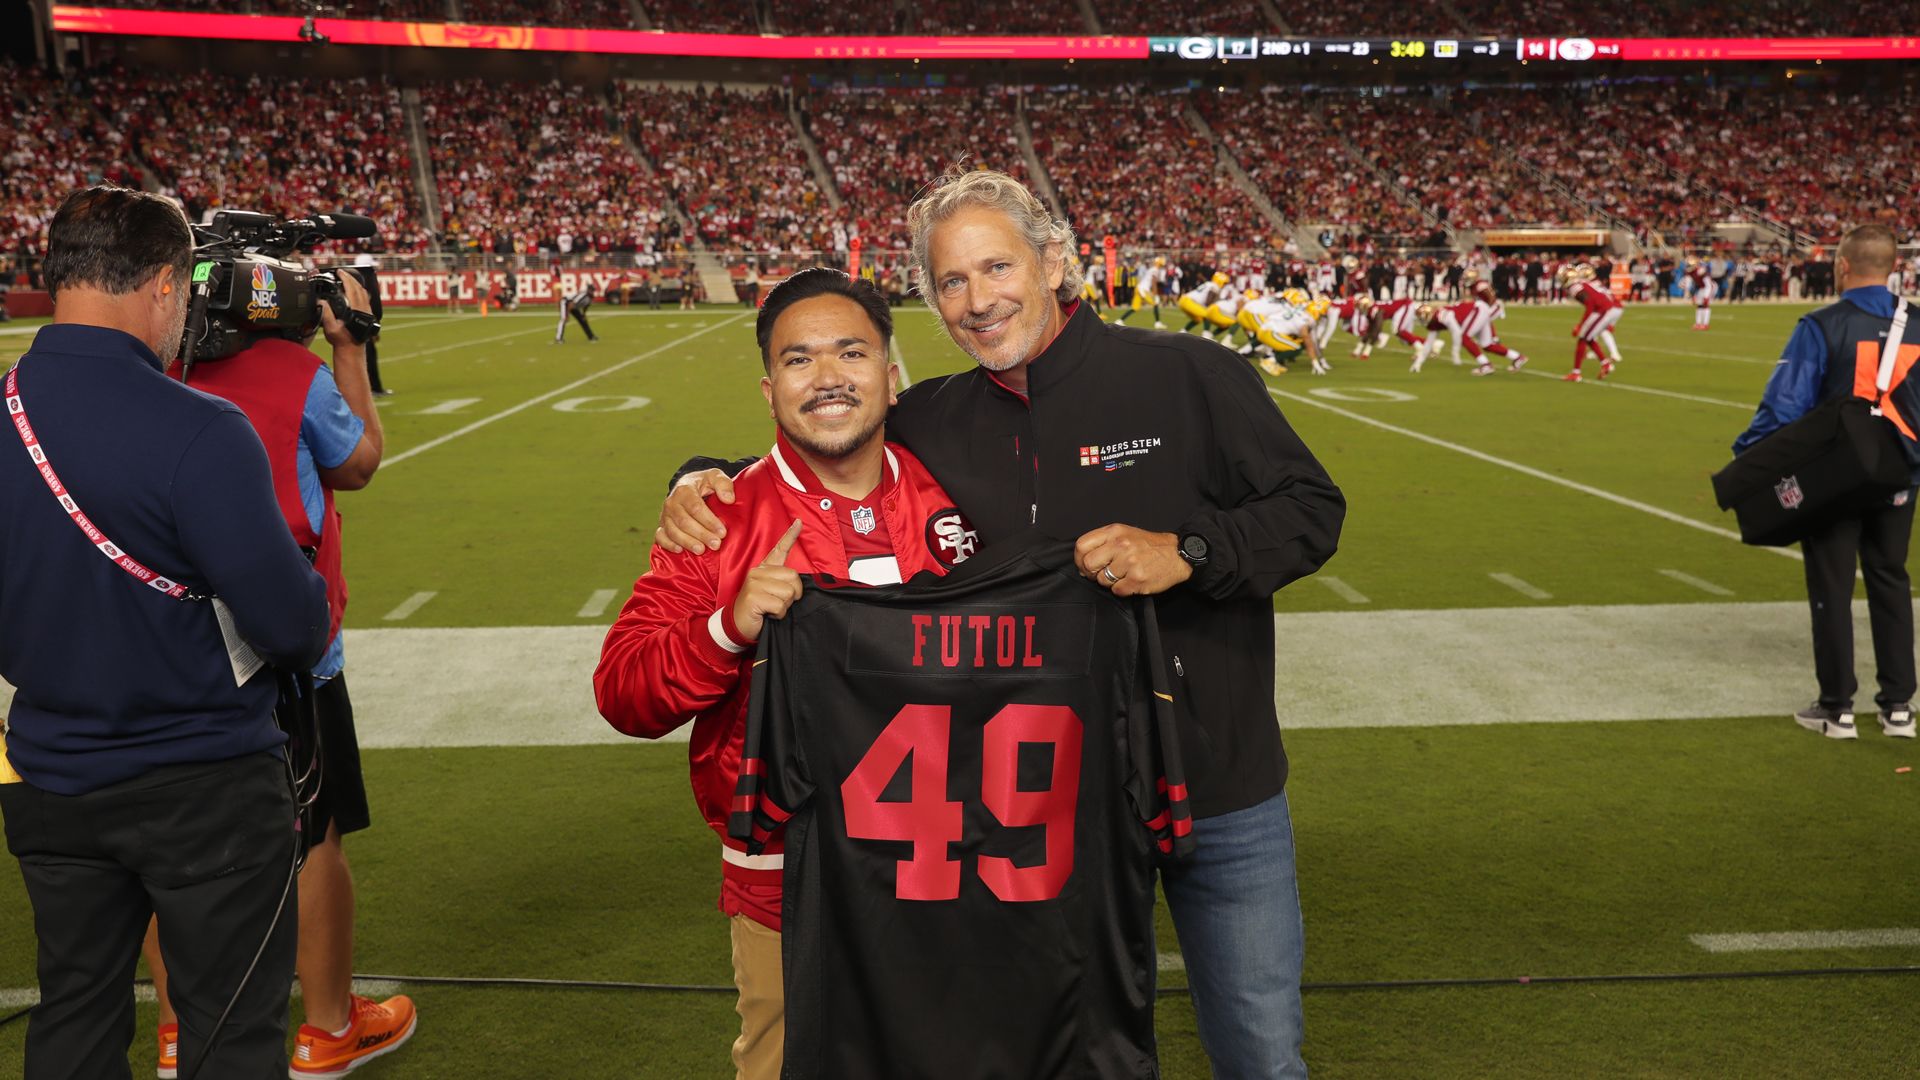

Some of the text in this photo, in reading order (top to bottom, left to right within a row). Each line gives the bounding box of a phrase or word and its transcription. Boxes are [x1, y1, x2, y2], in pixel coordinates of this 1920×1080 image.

[1231, 42, 1246, 55] 17
[1261, 42, 1291, 55] 2ND
[1302, 42, 1310, 55] 1
[1352, 42, 1370, 55] 23
[1390, 41, 1425, 57] 3:49
[1489, 42, 1499, 56] 3
[195, 266, 207, 278] 12
[252, 290, 278, 308] NBC
[247, 300, 280, 322] Sports
[16, 414, 33, 443] 49ERS
[1100, 437, 1161, 454] 49ERS STEM
[41, 464, 61, 493] 49ERS
[75, 513, 100, 541] 49ERS
[856, 518, 872, 531] NFL
[121, 558, 151, 580] 49ERS
[912, 614, 1043, 667] FUTOL
[840, 703, 1084, 902] 49
[356, 1031, 392, 1050] HOKA
